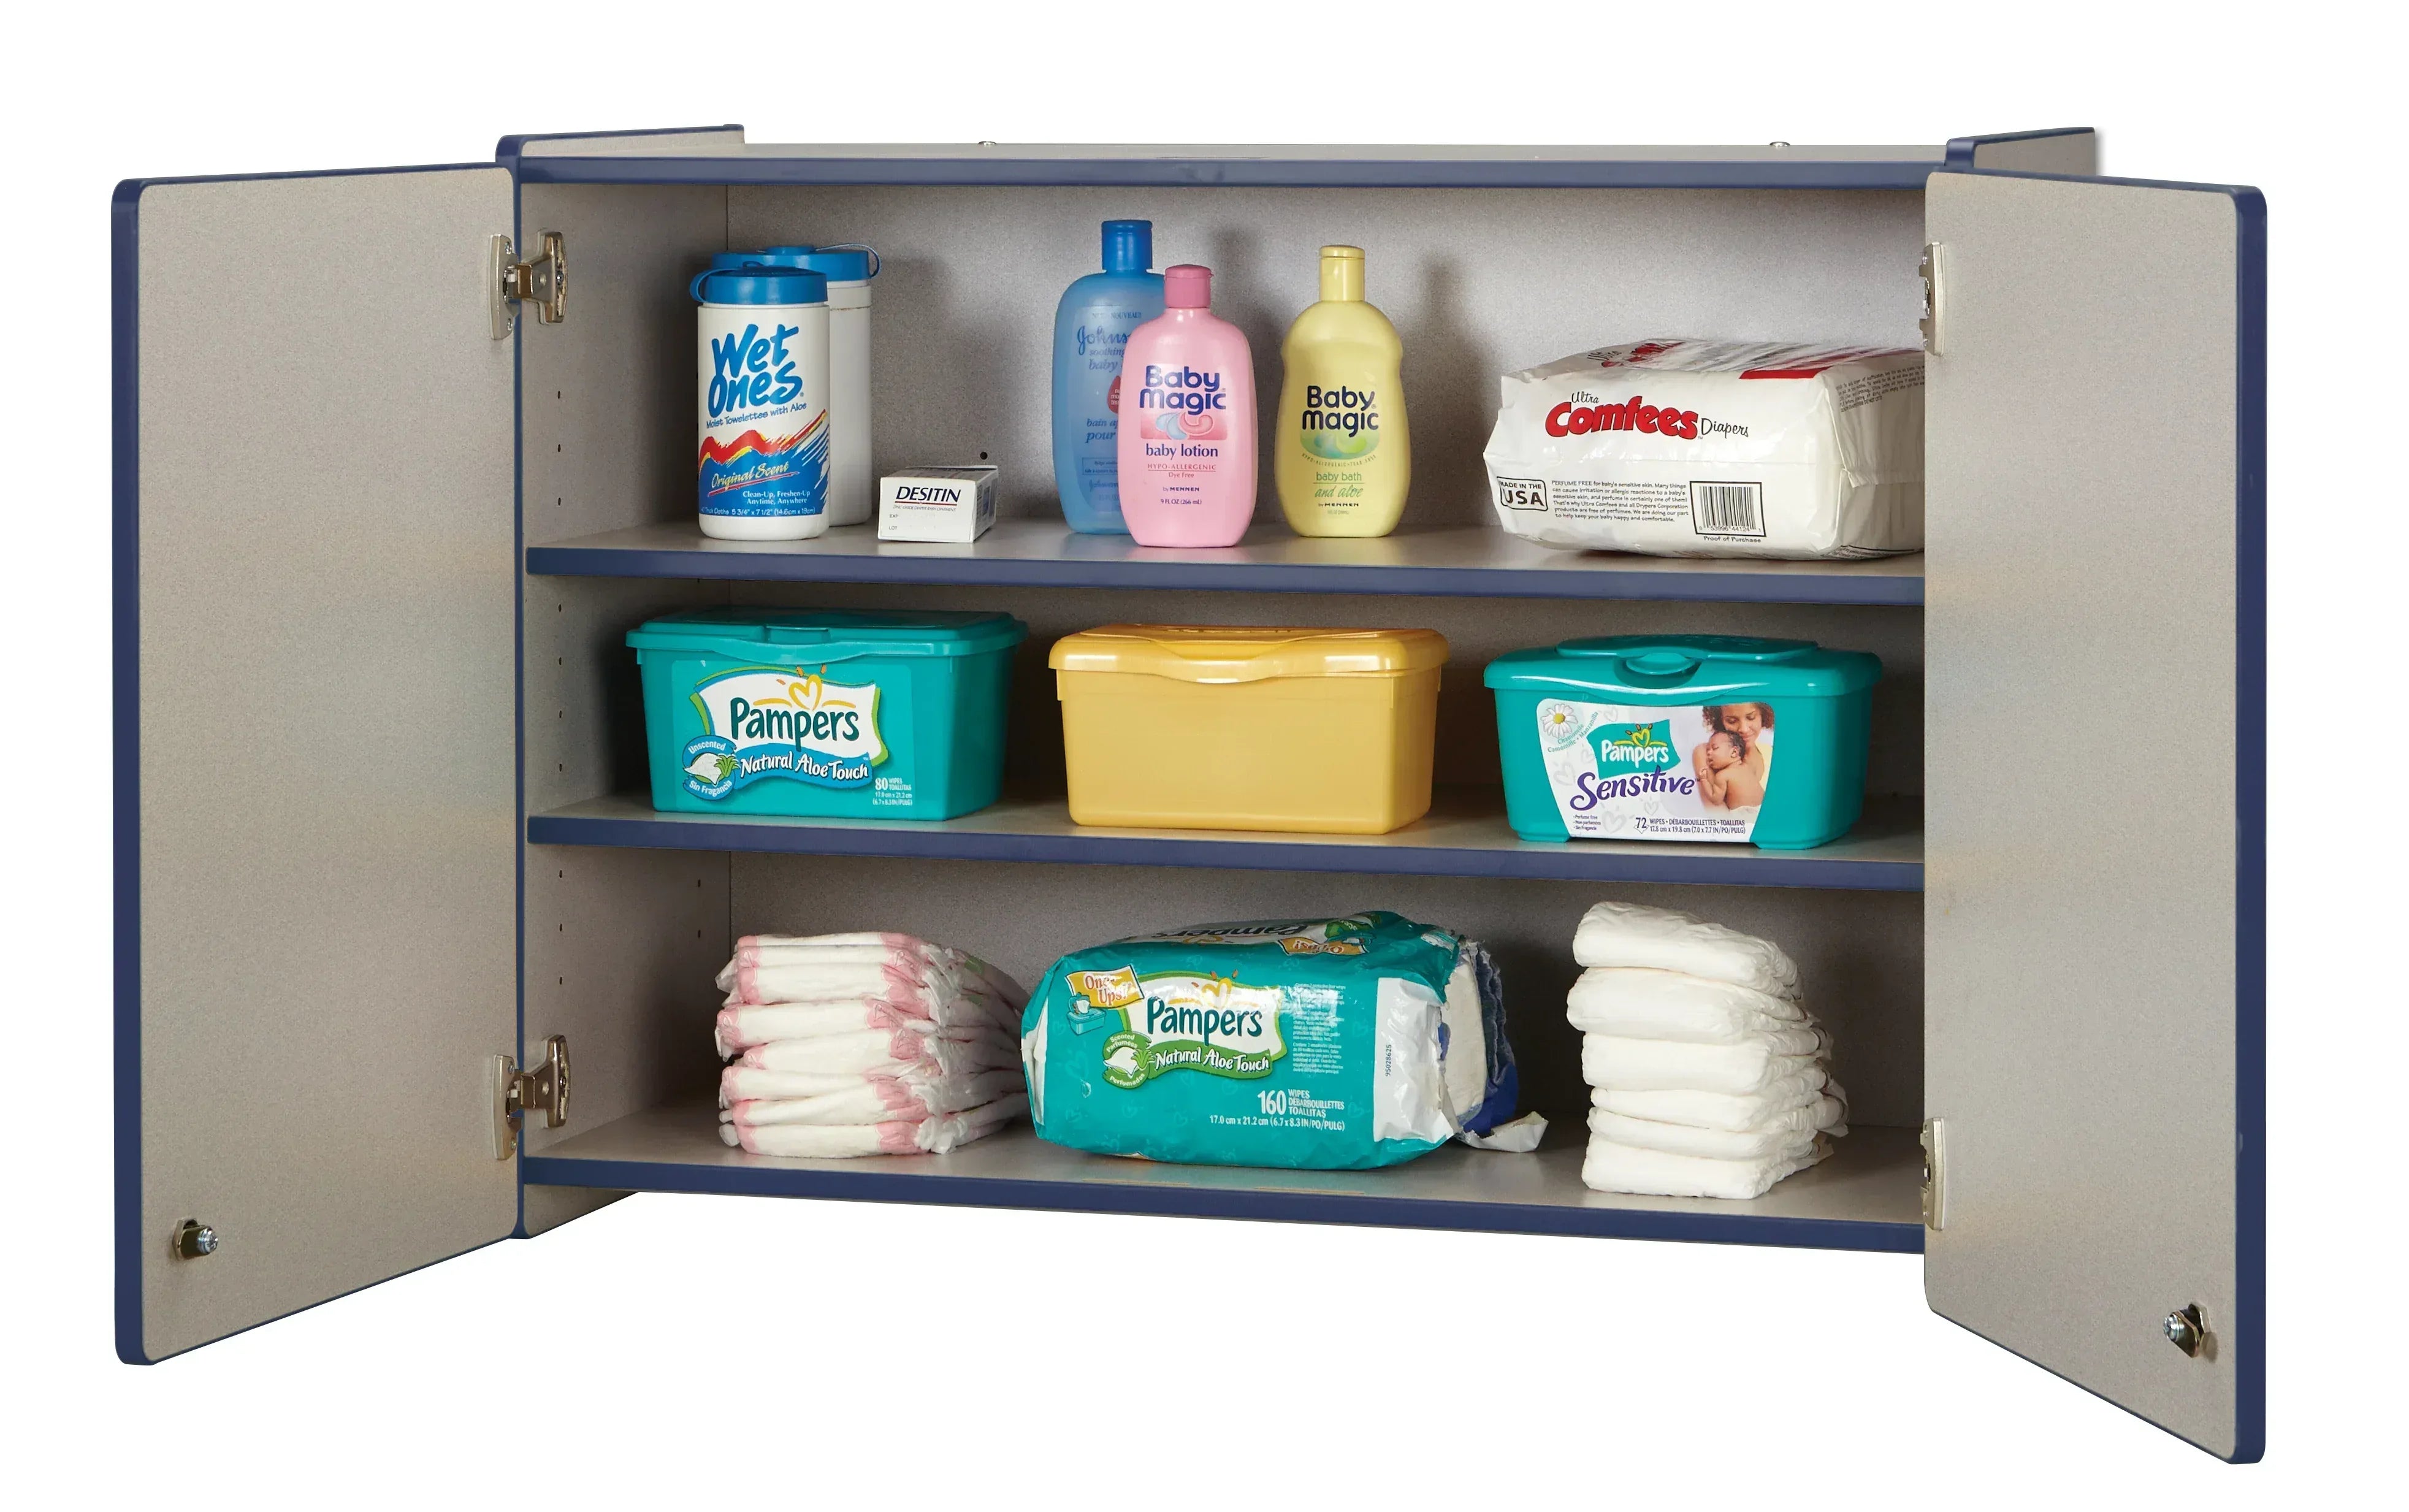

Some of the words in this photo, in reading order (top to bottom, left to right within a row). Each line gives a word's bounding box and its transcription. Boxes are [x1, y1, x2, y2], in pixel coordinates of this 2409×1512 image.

[1077, 326, 1131, 355] Johns
[712, 324, 799, 378] Wet
[1089, 359, 1118, 373] baby
[1145, 365, 1220, 392] Baby
[708, 361, 803, 418] Ones
[1307, 385, 1375, 411] Baby
[1571, 391, 1599, 403] Ultra
[706, 419, 723, 429] Moist
[724, 411, 768, 426] Towelettes
[770, 406, 788, 416] with
[790, 402, 807, 412] Aloe
[1086, 419, 1107, 427] bain
[1545, 395, 1698, 440] Comfees
[1701, 418, 1749, 438] Diapers
[1085, 432, 1116, 444] pour
[1146, 443, 1177, 460] baby
[1181, 443, 1218, 457] lotion
[711, 465, 755, 491] Original
[755, 461, 789, 479] Scent
[1316, 472, 1339, 482] baby
[1342, 472, 1362, 481] bath
[896, 486, 961, 502] DESITIN
[1315, 485, 1337, 497] and
[1338, 484, 1364, 497] aloe
[1502, 489, 1545, 506] USA
[730, 697, 860, 752] Pampers
[1557, 724, 1584, 744] Chamomile
[1579, 711, 1599, 738] Manzanilla
[688, 741, 727, 754] Unscented
[1601, 739, 1670, 769] Pampers
[741, 750, 793, 778] Natural
[795, 753, 828, 777] Aloe
[828, 760, 869, 780] Touch
[689, 780, 700, 791] Sin
[701, 780, 733, 797] Fragancia
[875, 777, 888, 790] 80
[1570, 765, 1695, 811] Sensitive
[1635, 817, 1647, 828] 72
[1147, 996, 1262, 1046] Pampers
[1110, 1034, 1135, 1043] Scented
[1155, 1046, 1202, 1071] Natural
[1203, 1048, 1233, 1069] Aloe
[1233, 1054, 1270, 1072] Touch
[1258, 1090, 1287, 1115] 160
[1288, 1088, 1310, 1099] WIPES
[1209, 1115, 1224, 1124] 17.0
[1243, 1116, 1257, 1125] 21.2
[1270, 1115, 1283, 1128] (6.7
[1288, 1106, 1326, 1118] TOALLITAS
